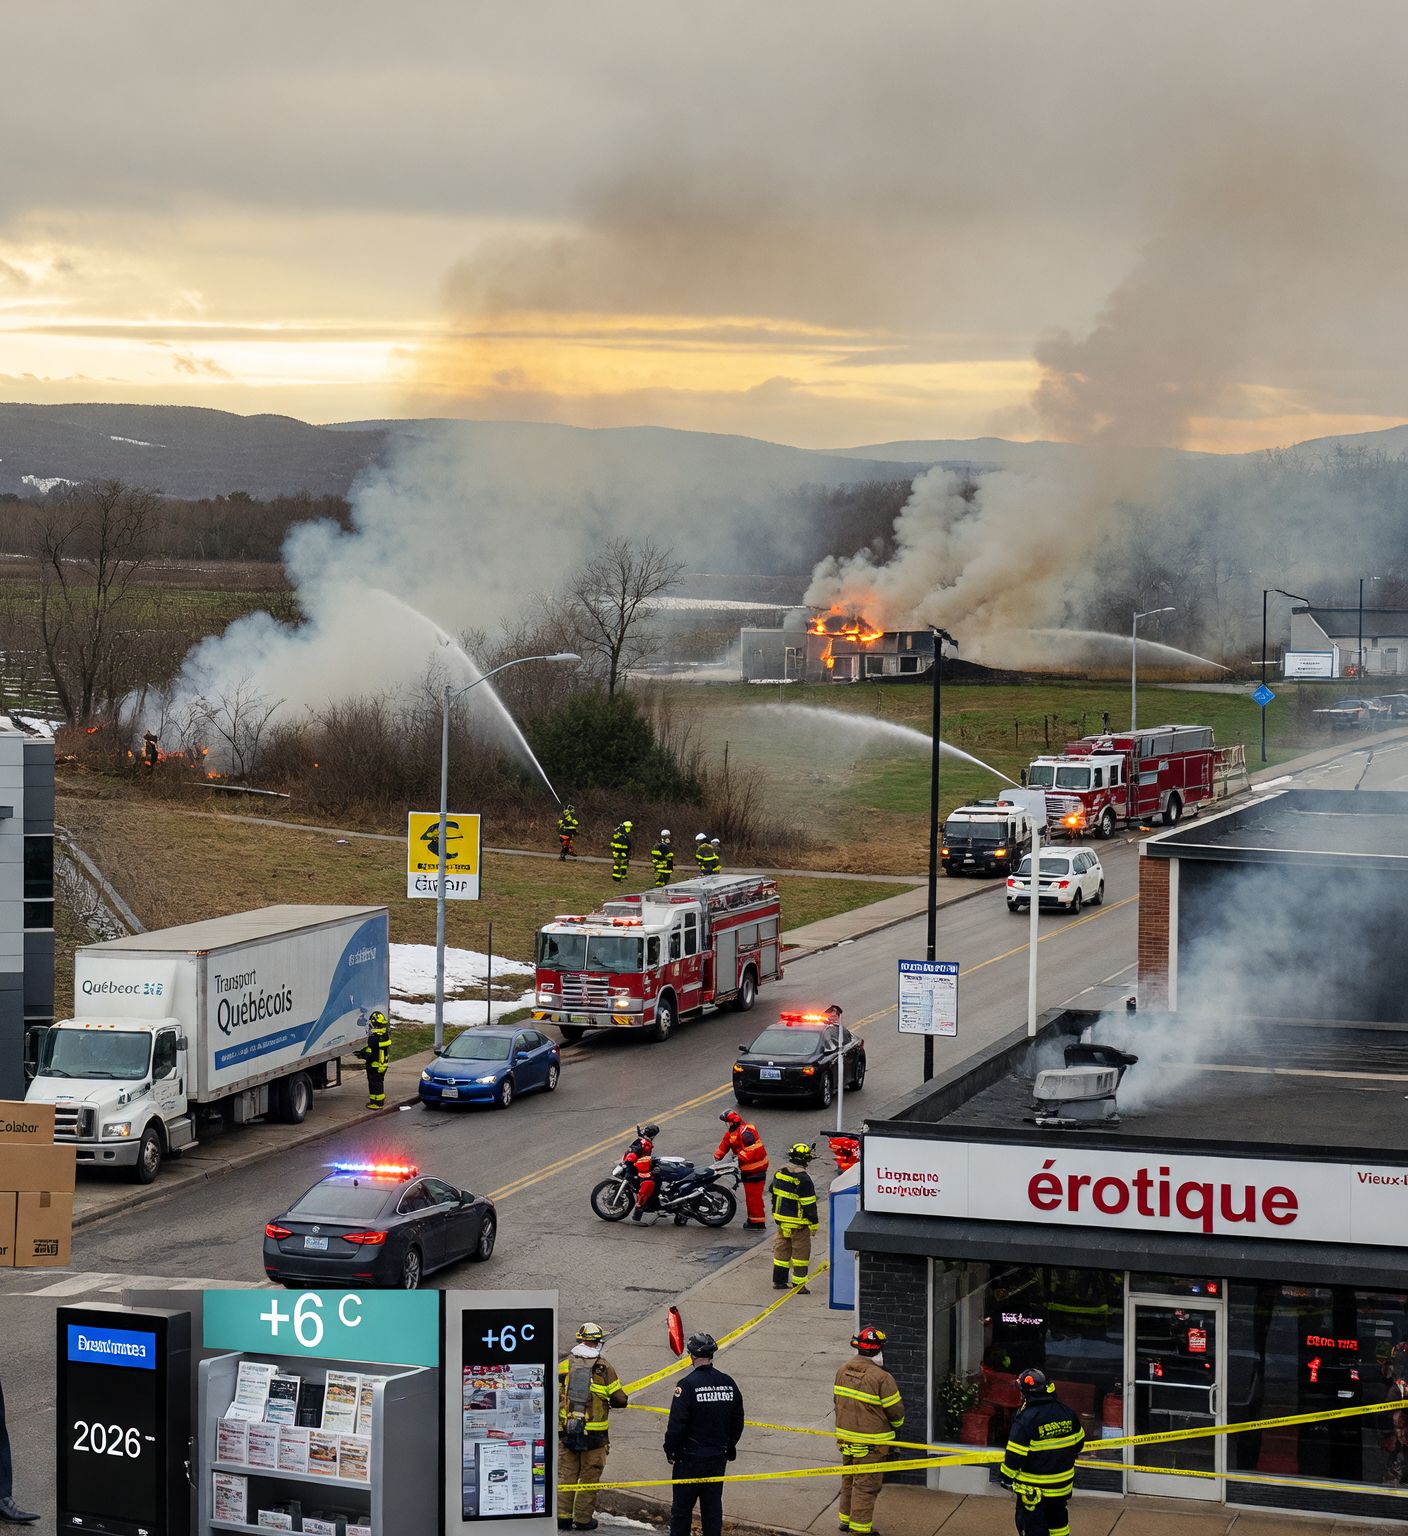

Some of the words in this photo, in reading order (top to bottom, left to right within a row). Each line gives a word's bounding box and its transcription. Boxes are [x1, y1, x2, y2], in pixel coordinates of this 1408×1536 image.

[218, 984, 292, 1036] Québécois
[1028, 1159, 1298, 1233] érotique
[338, 1293, 362, 1328] C
